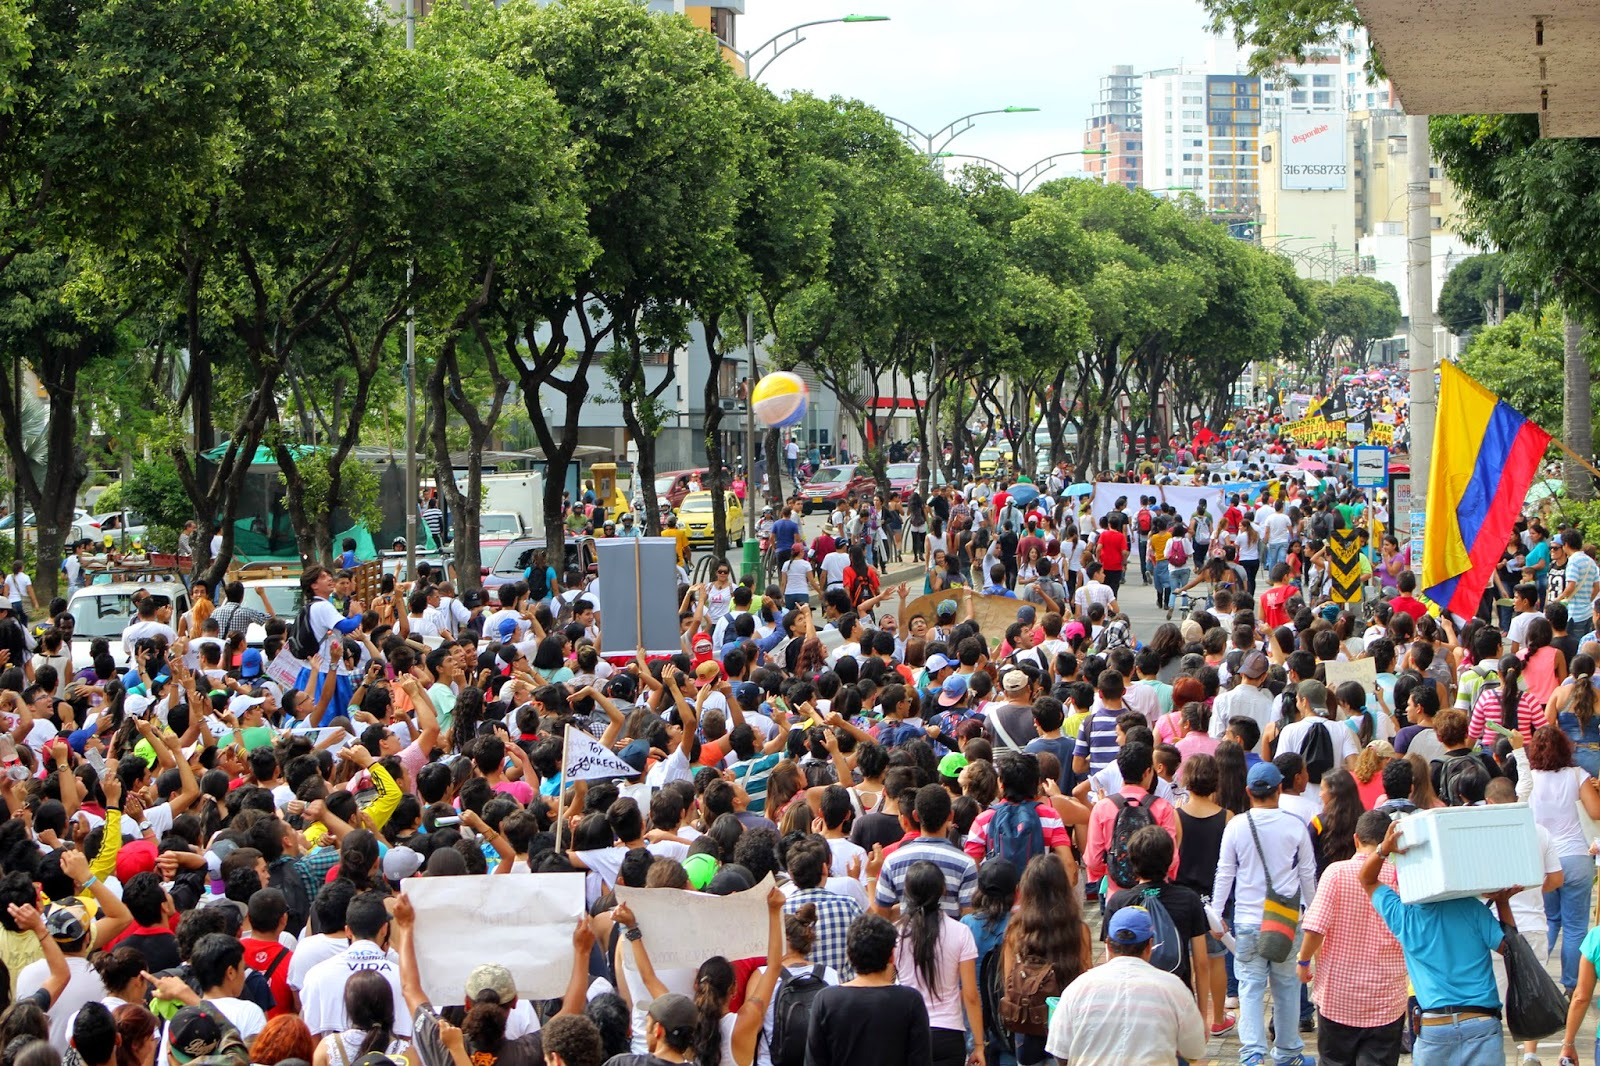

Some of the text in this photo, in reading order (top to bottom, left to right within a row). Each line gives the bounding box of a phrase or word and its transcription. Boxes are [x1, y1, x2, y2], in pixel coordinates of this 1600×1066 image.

[1291, 124, 1328, 144] disponible
[1283, 164, 1347, 175] 316 7658733
[580, 756, 631, 773] ARRECHO
[347, 962, 392, 972] VIDA
